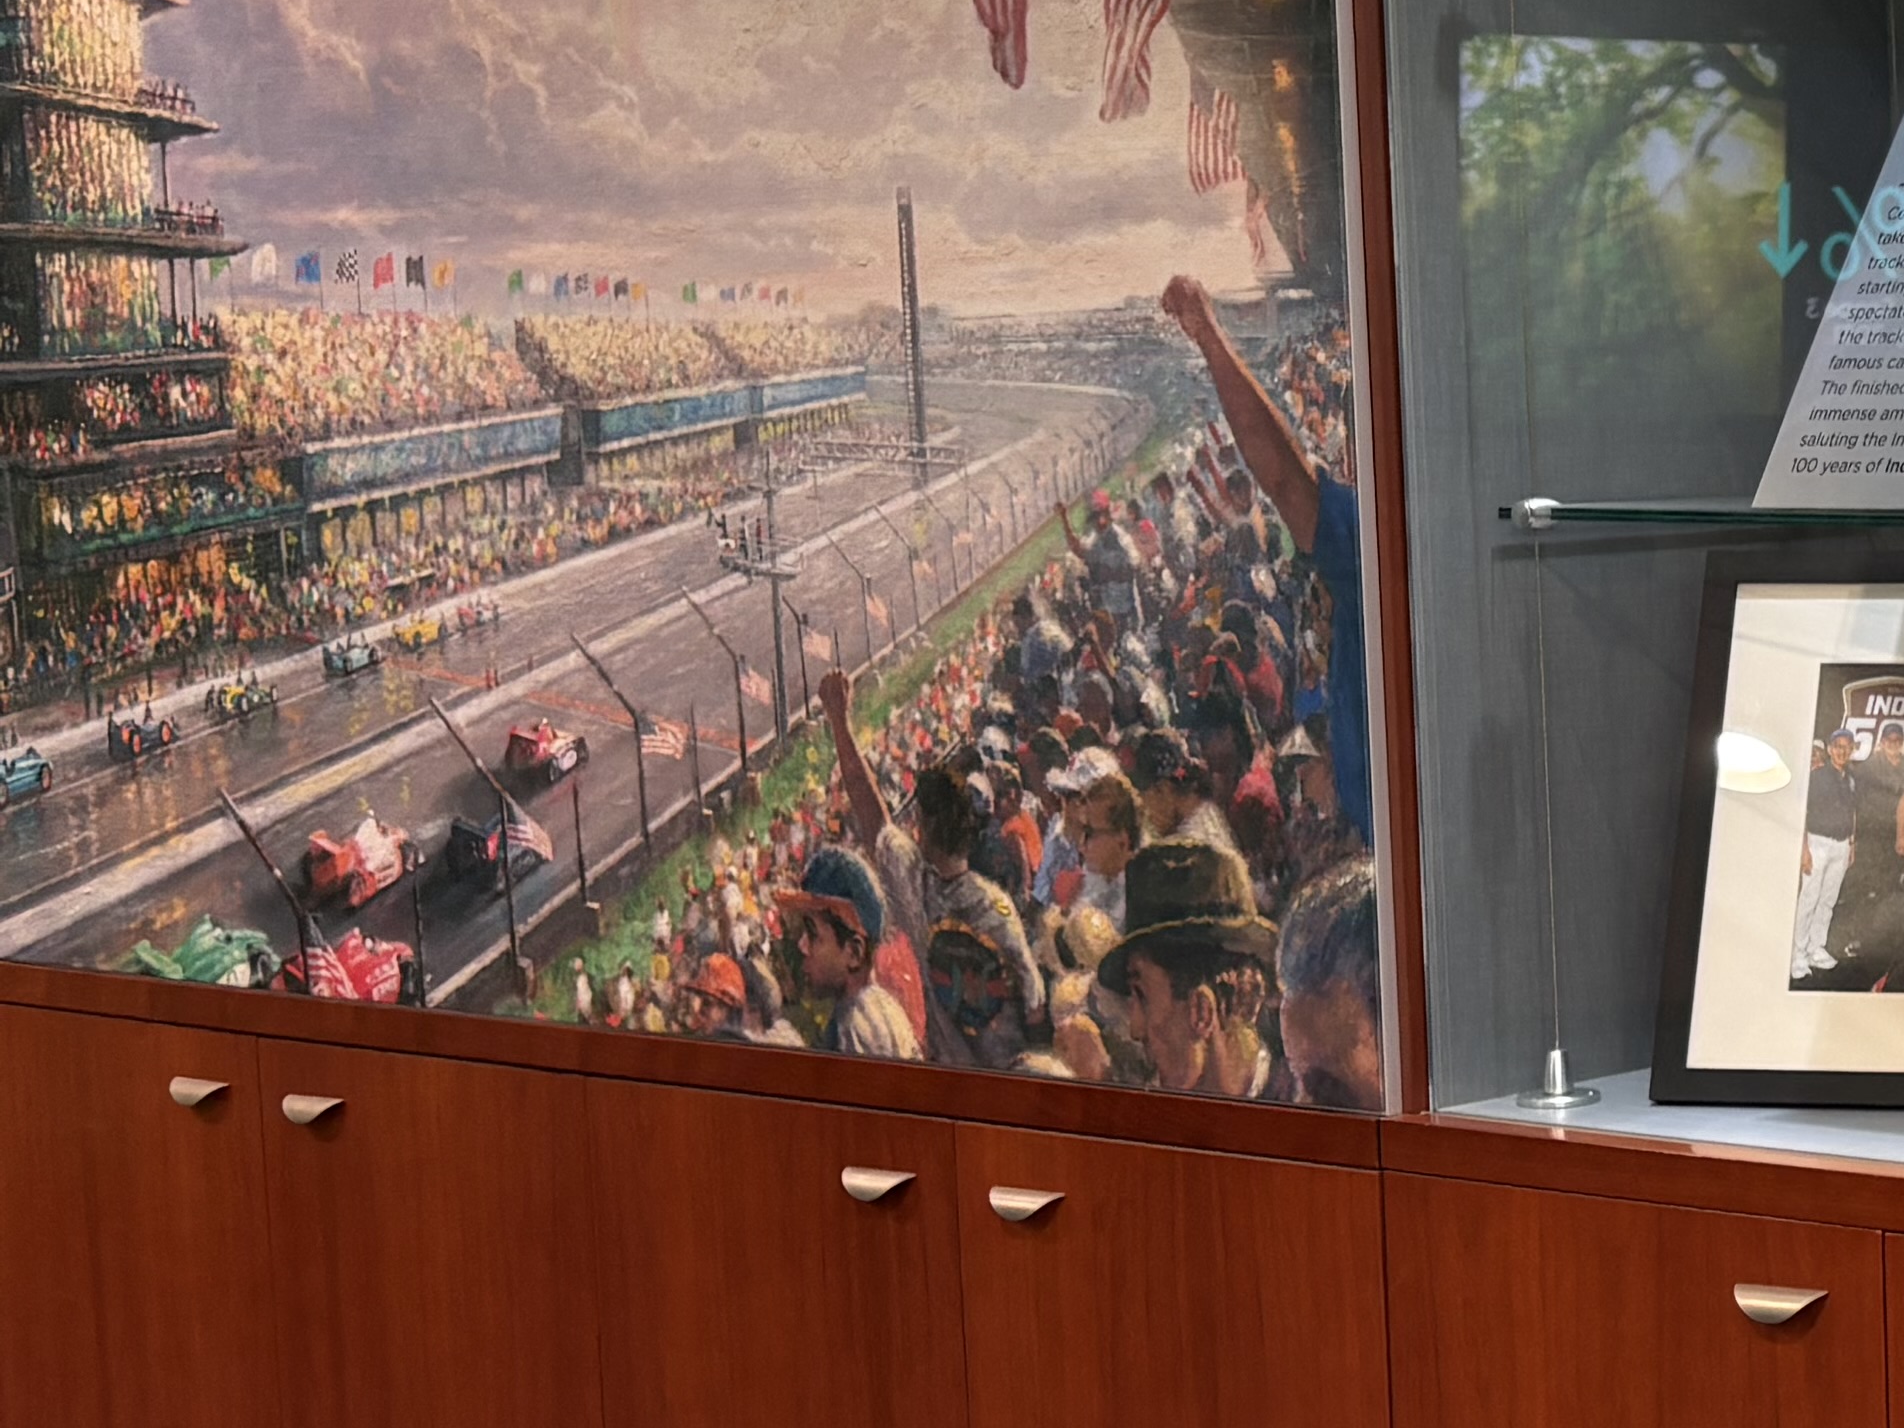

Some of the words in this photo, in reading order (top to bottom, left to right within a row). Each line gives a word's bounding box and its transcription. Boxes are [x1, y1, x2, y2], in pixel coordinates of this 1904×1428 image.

[1839, 330, 1863, 344] the
[1867, 328, 1904, 344] track
[1829, 355, 1883, 370] famous
[1820, 380, 1847, 396] The
[1809, 406, 1877, 421] immense
[1800, 432, 1858, 448] saluting
[1863, 432, 1886, 447] the
[1791, 458, 1817, 474] 100
[1820, 459, 1861, 476] years
[1865, 458, 1884, 474] of
